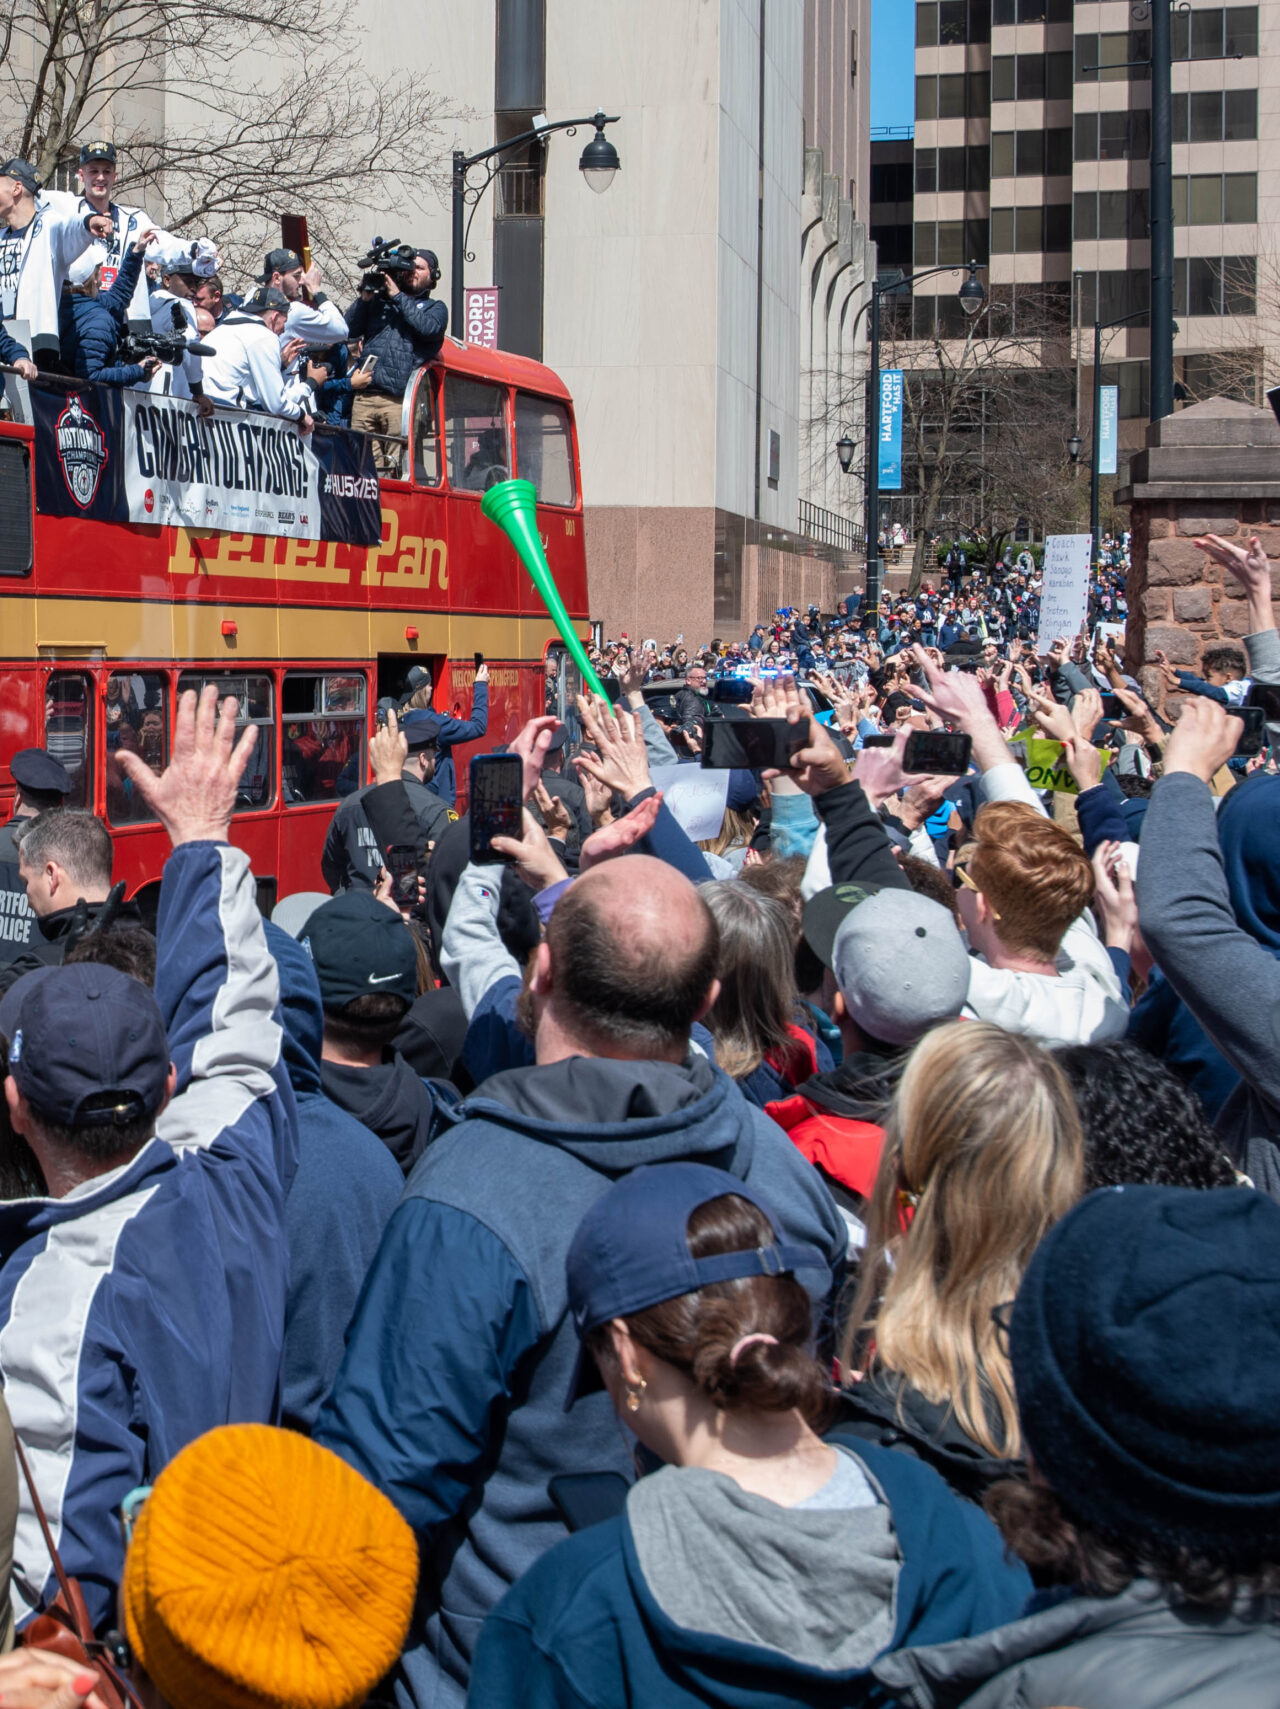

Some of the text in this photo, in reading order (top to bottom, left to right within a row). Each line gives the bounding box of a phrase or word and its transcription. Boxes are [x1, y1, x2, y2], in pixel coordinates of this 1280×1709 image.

[469, 294, 483, 345] FORD
[484, 294, 495, 340] HAS IT
[882, 374, 893, 442] HARTFORD
[893, 374, 901, 405] HAS IT
[135, 404, 309, 499] CONGRATULATIONS!
[360, 508, 449, 590] Pan
[1051, 538, 1076, 549] Coach
[451, 669, 476, 687] WELCOM
